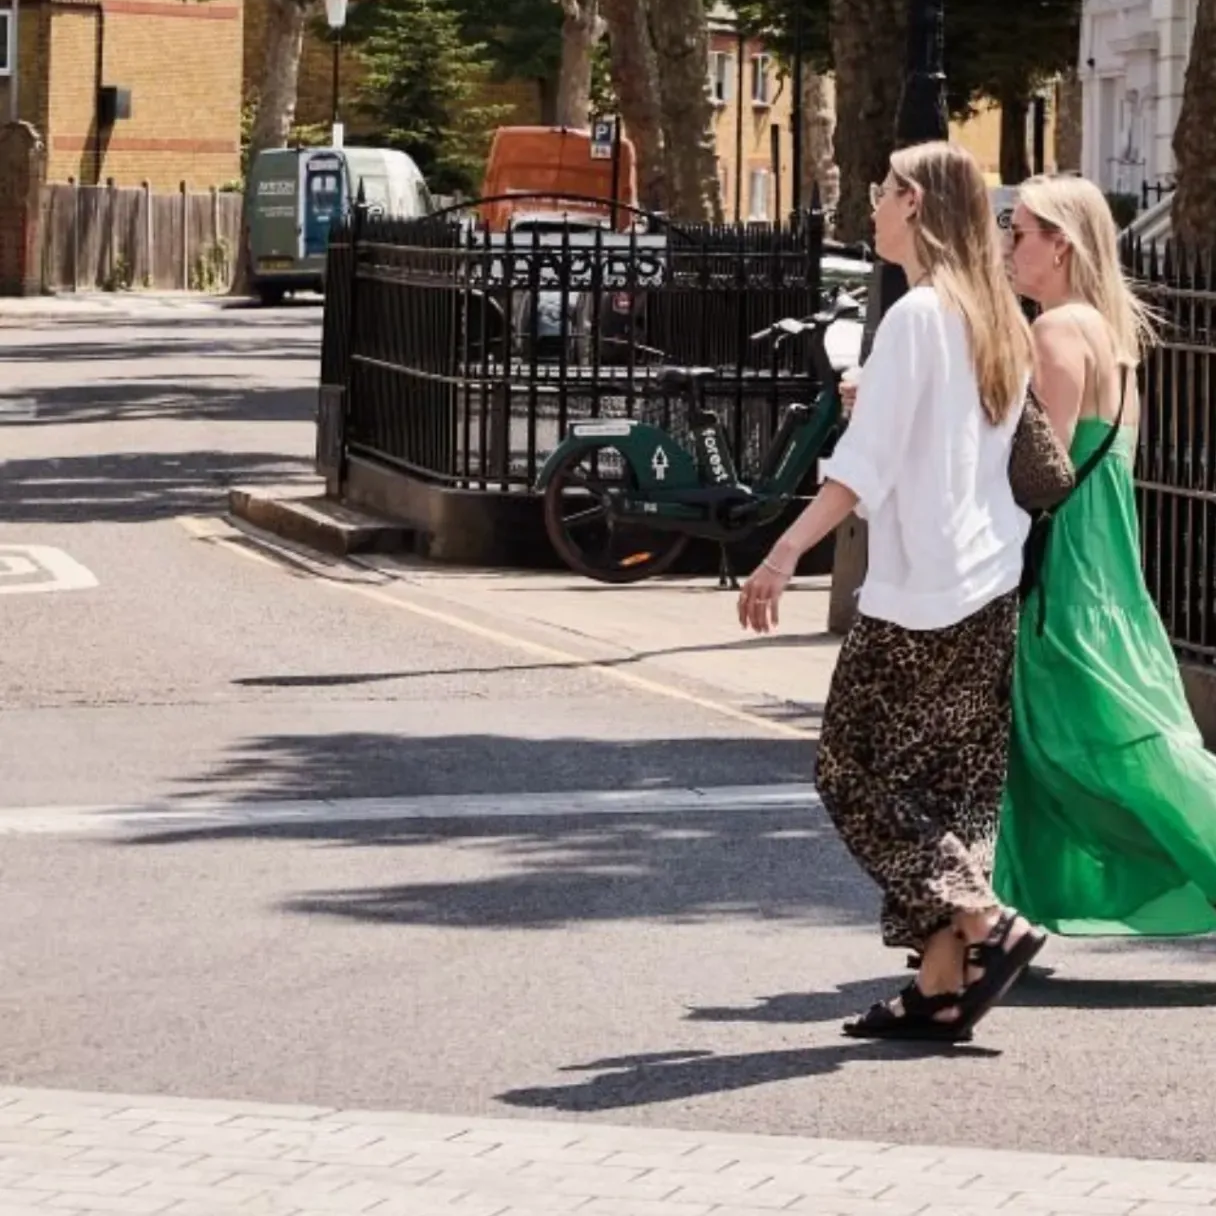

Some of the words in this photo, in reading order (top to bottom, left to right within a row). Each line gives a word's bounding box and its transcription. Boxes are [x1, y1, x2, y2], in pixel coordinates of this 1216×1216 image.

[595, 123, 609, 140] P
[505, 247, 664, 278] LADES
[702, 427, 729, 483] forest
